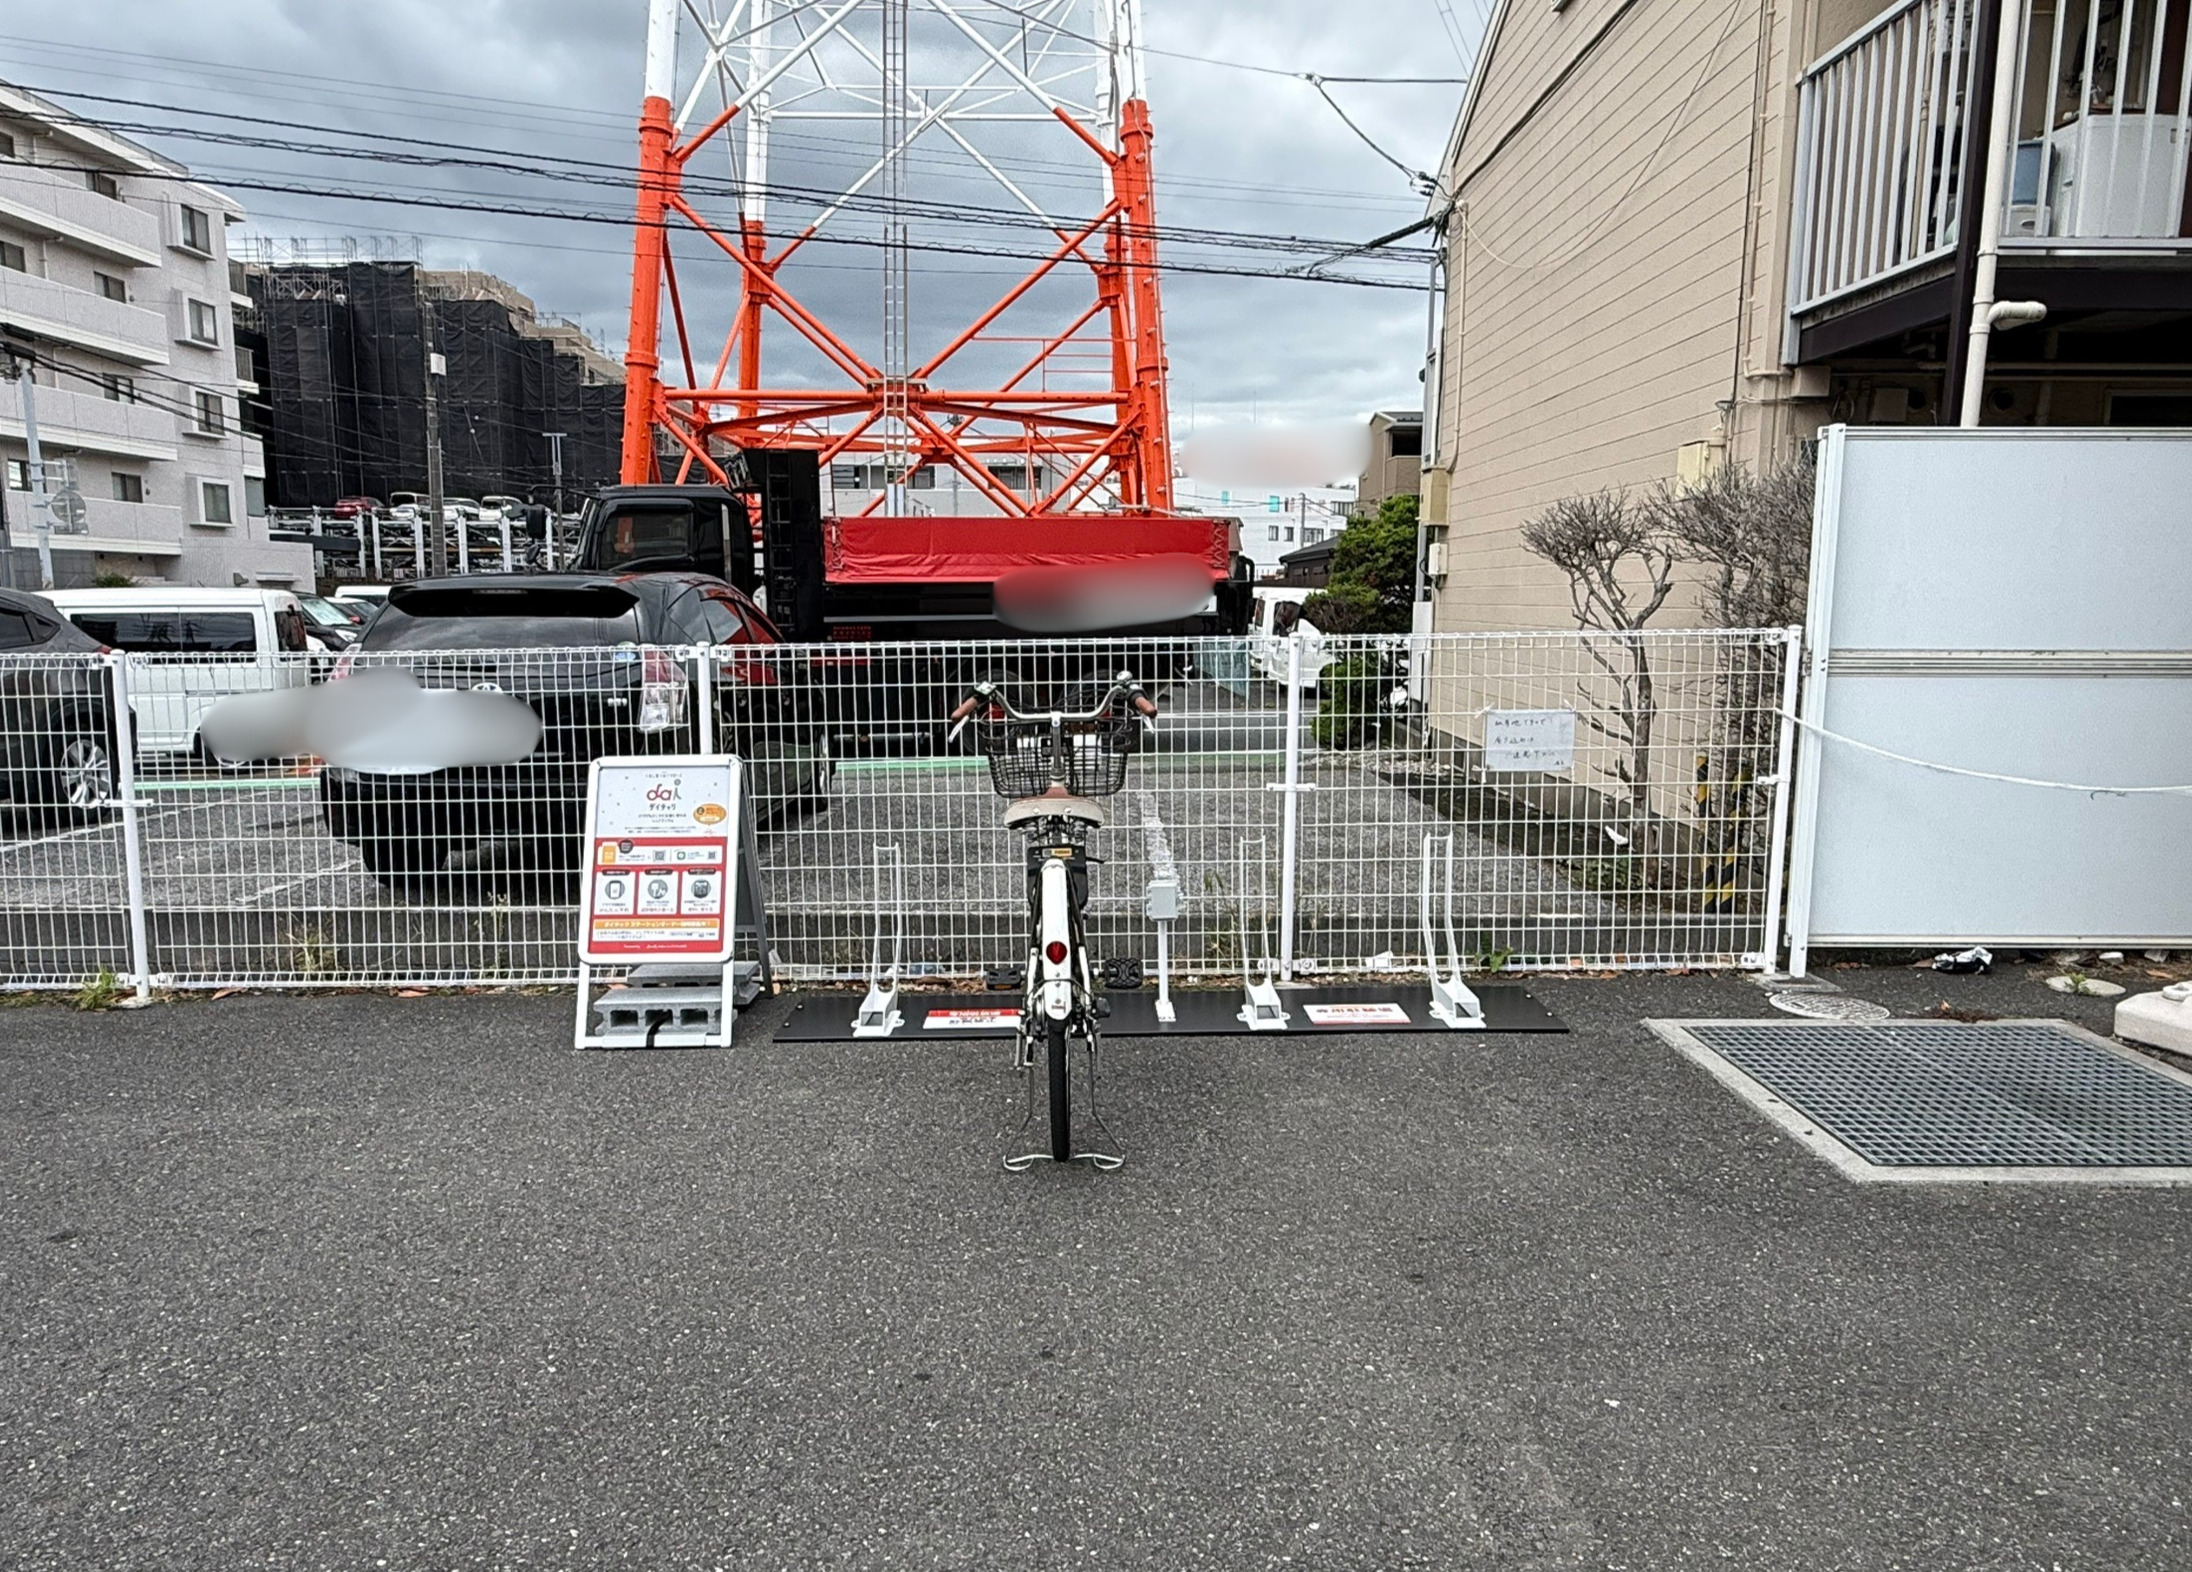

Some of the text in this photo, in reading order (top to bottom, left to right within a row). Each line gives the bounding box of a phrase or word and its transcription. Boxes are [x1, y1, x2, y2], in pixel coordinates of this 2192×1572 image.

[649, 803, 676, 811] ダイチャリ
